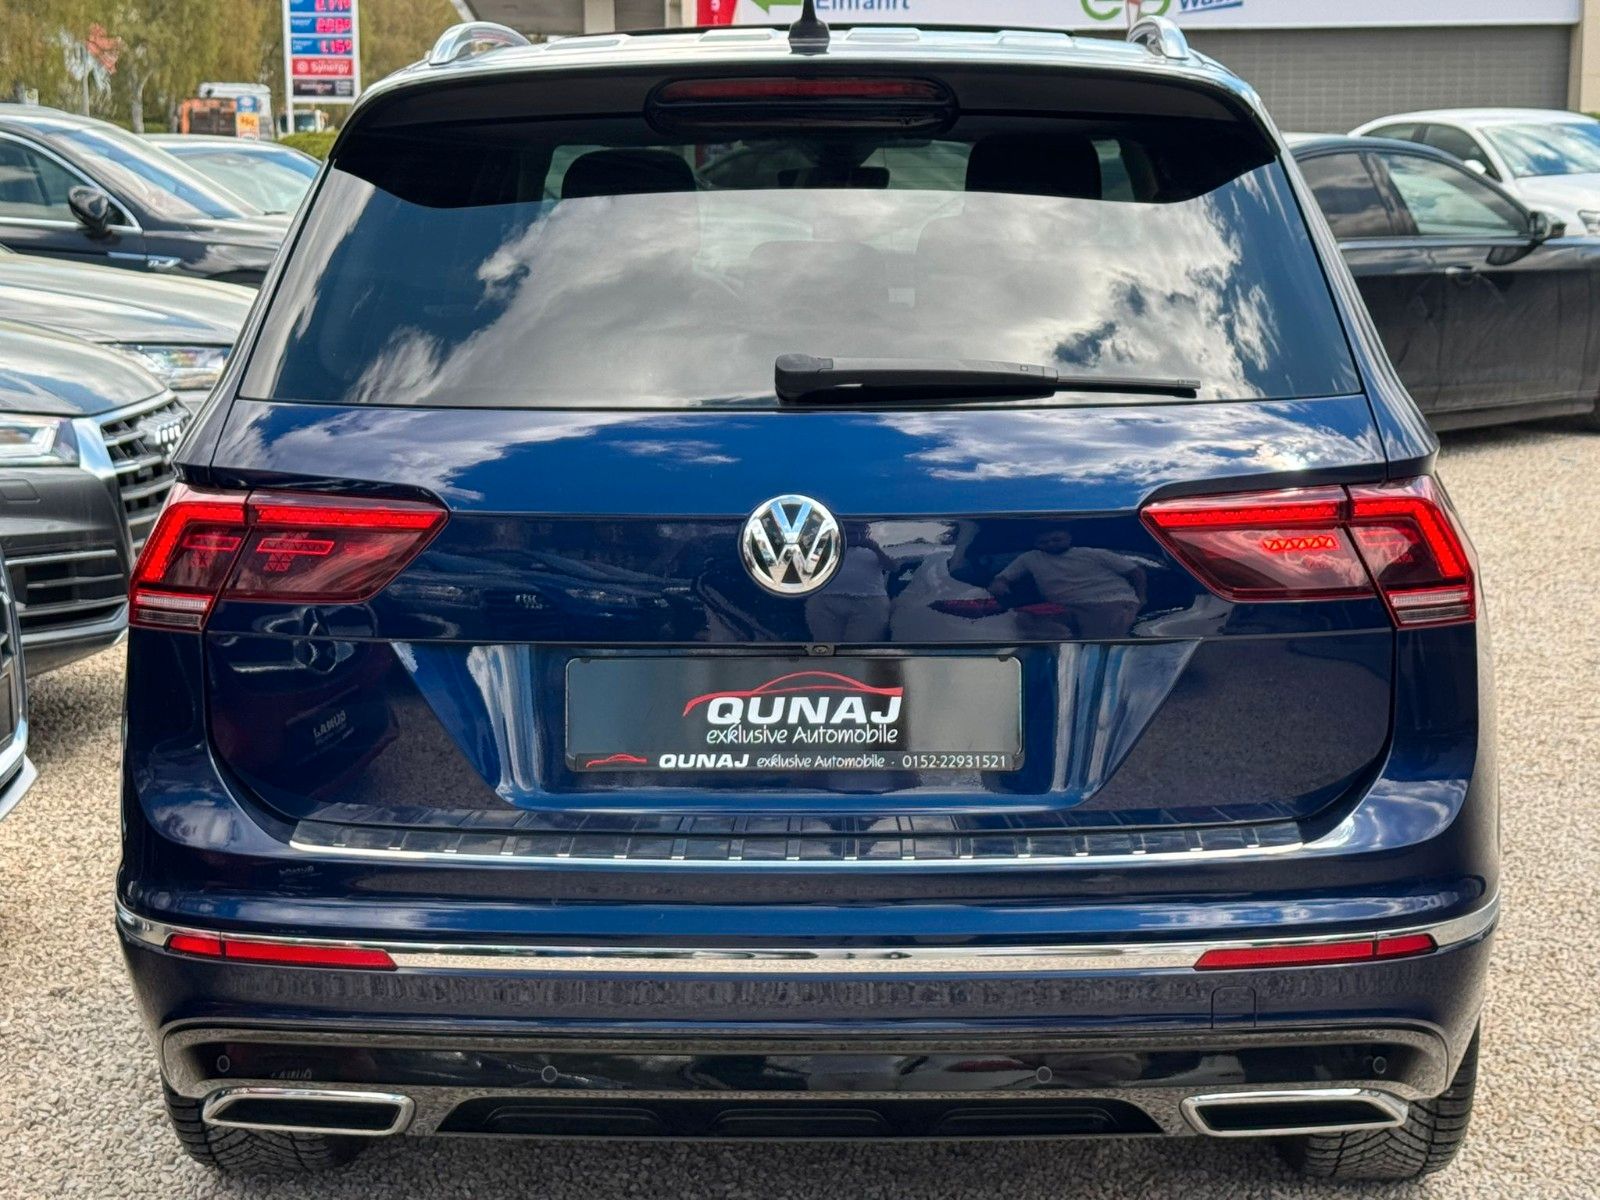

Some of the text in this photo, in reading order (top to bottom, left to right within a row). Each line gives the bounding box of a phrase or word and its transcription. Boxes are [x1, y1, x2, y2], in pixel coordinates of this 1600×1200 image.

[310, 60, 350, 74] Synergy
[706, 696, 903, 724] QUNAJ
[706, 724, 898, 744] exklusive Automobile
[658, 753, 750, 769] QUNAJ
[756, 754, 811, 769] exklusive
[814, 754, 885, 769] Automobile
